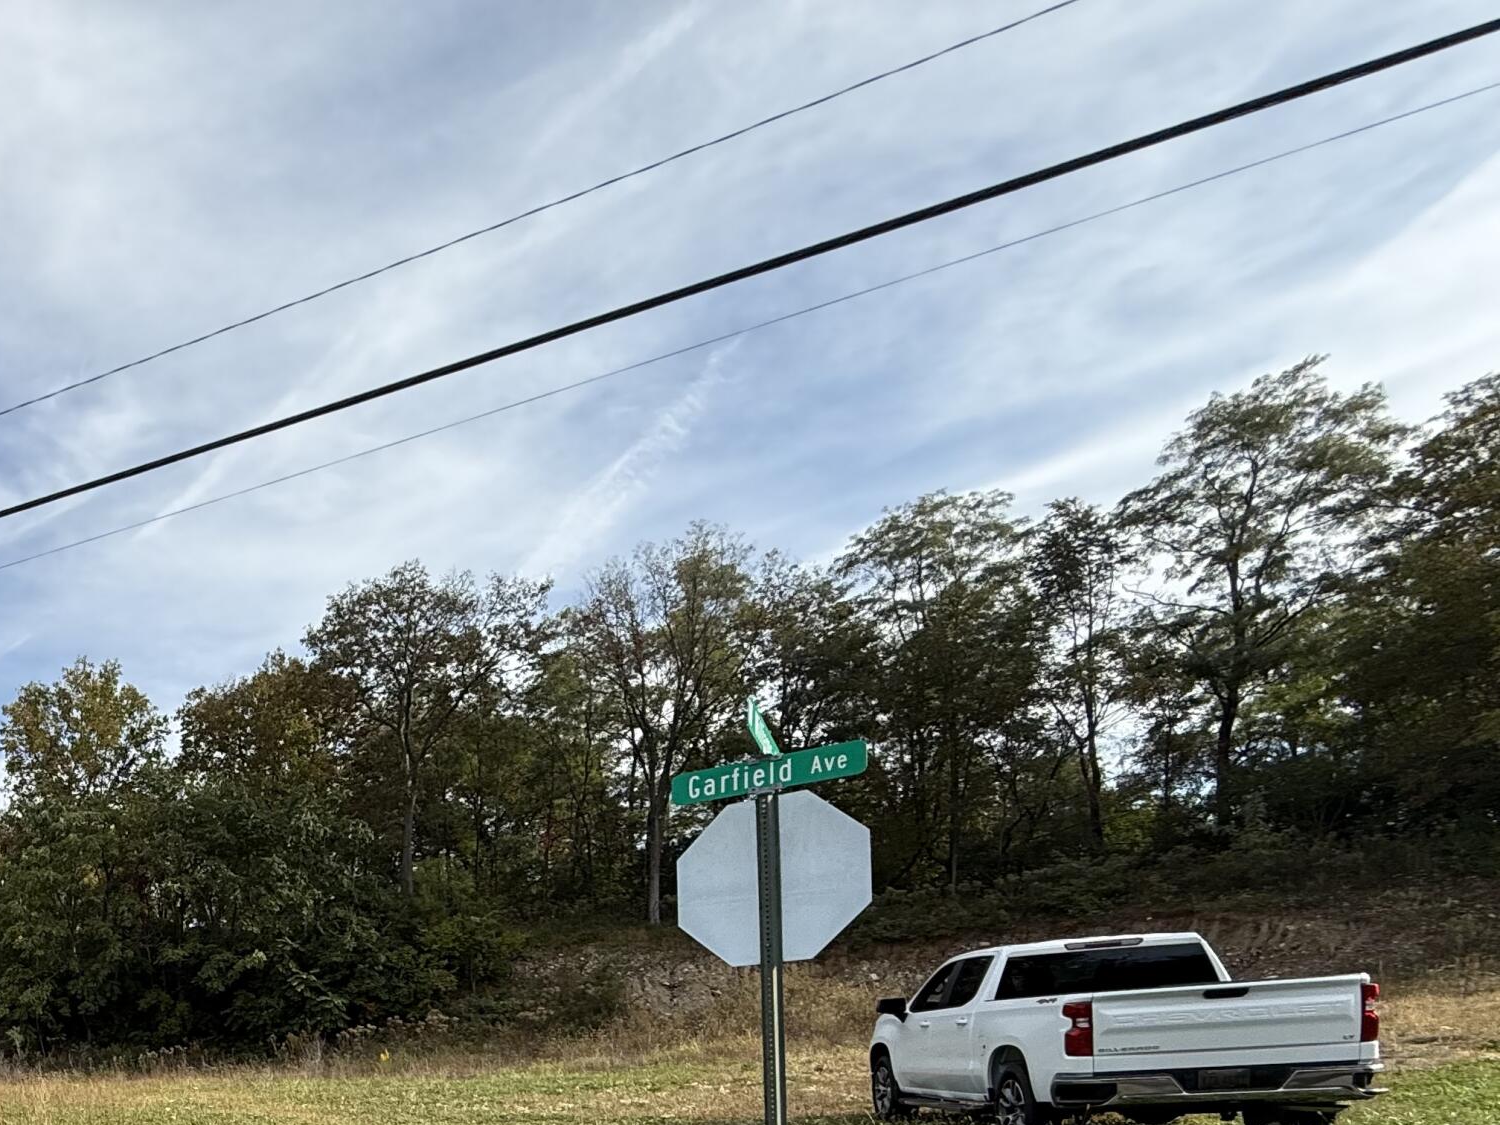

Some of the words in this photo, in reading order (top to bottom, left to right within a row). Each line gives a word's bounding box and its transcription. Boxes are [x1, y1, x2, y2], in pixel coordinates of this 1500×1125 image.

[688, 758, 793, 799] Garfield
[810, 753, 849, 775] Ave
[1115, 1002, 1341, 1026] CHEVROLET
